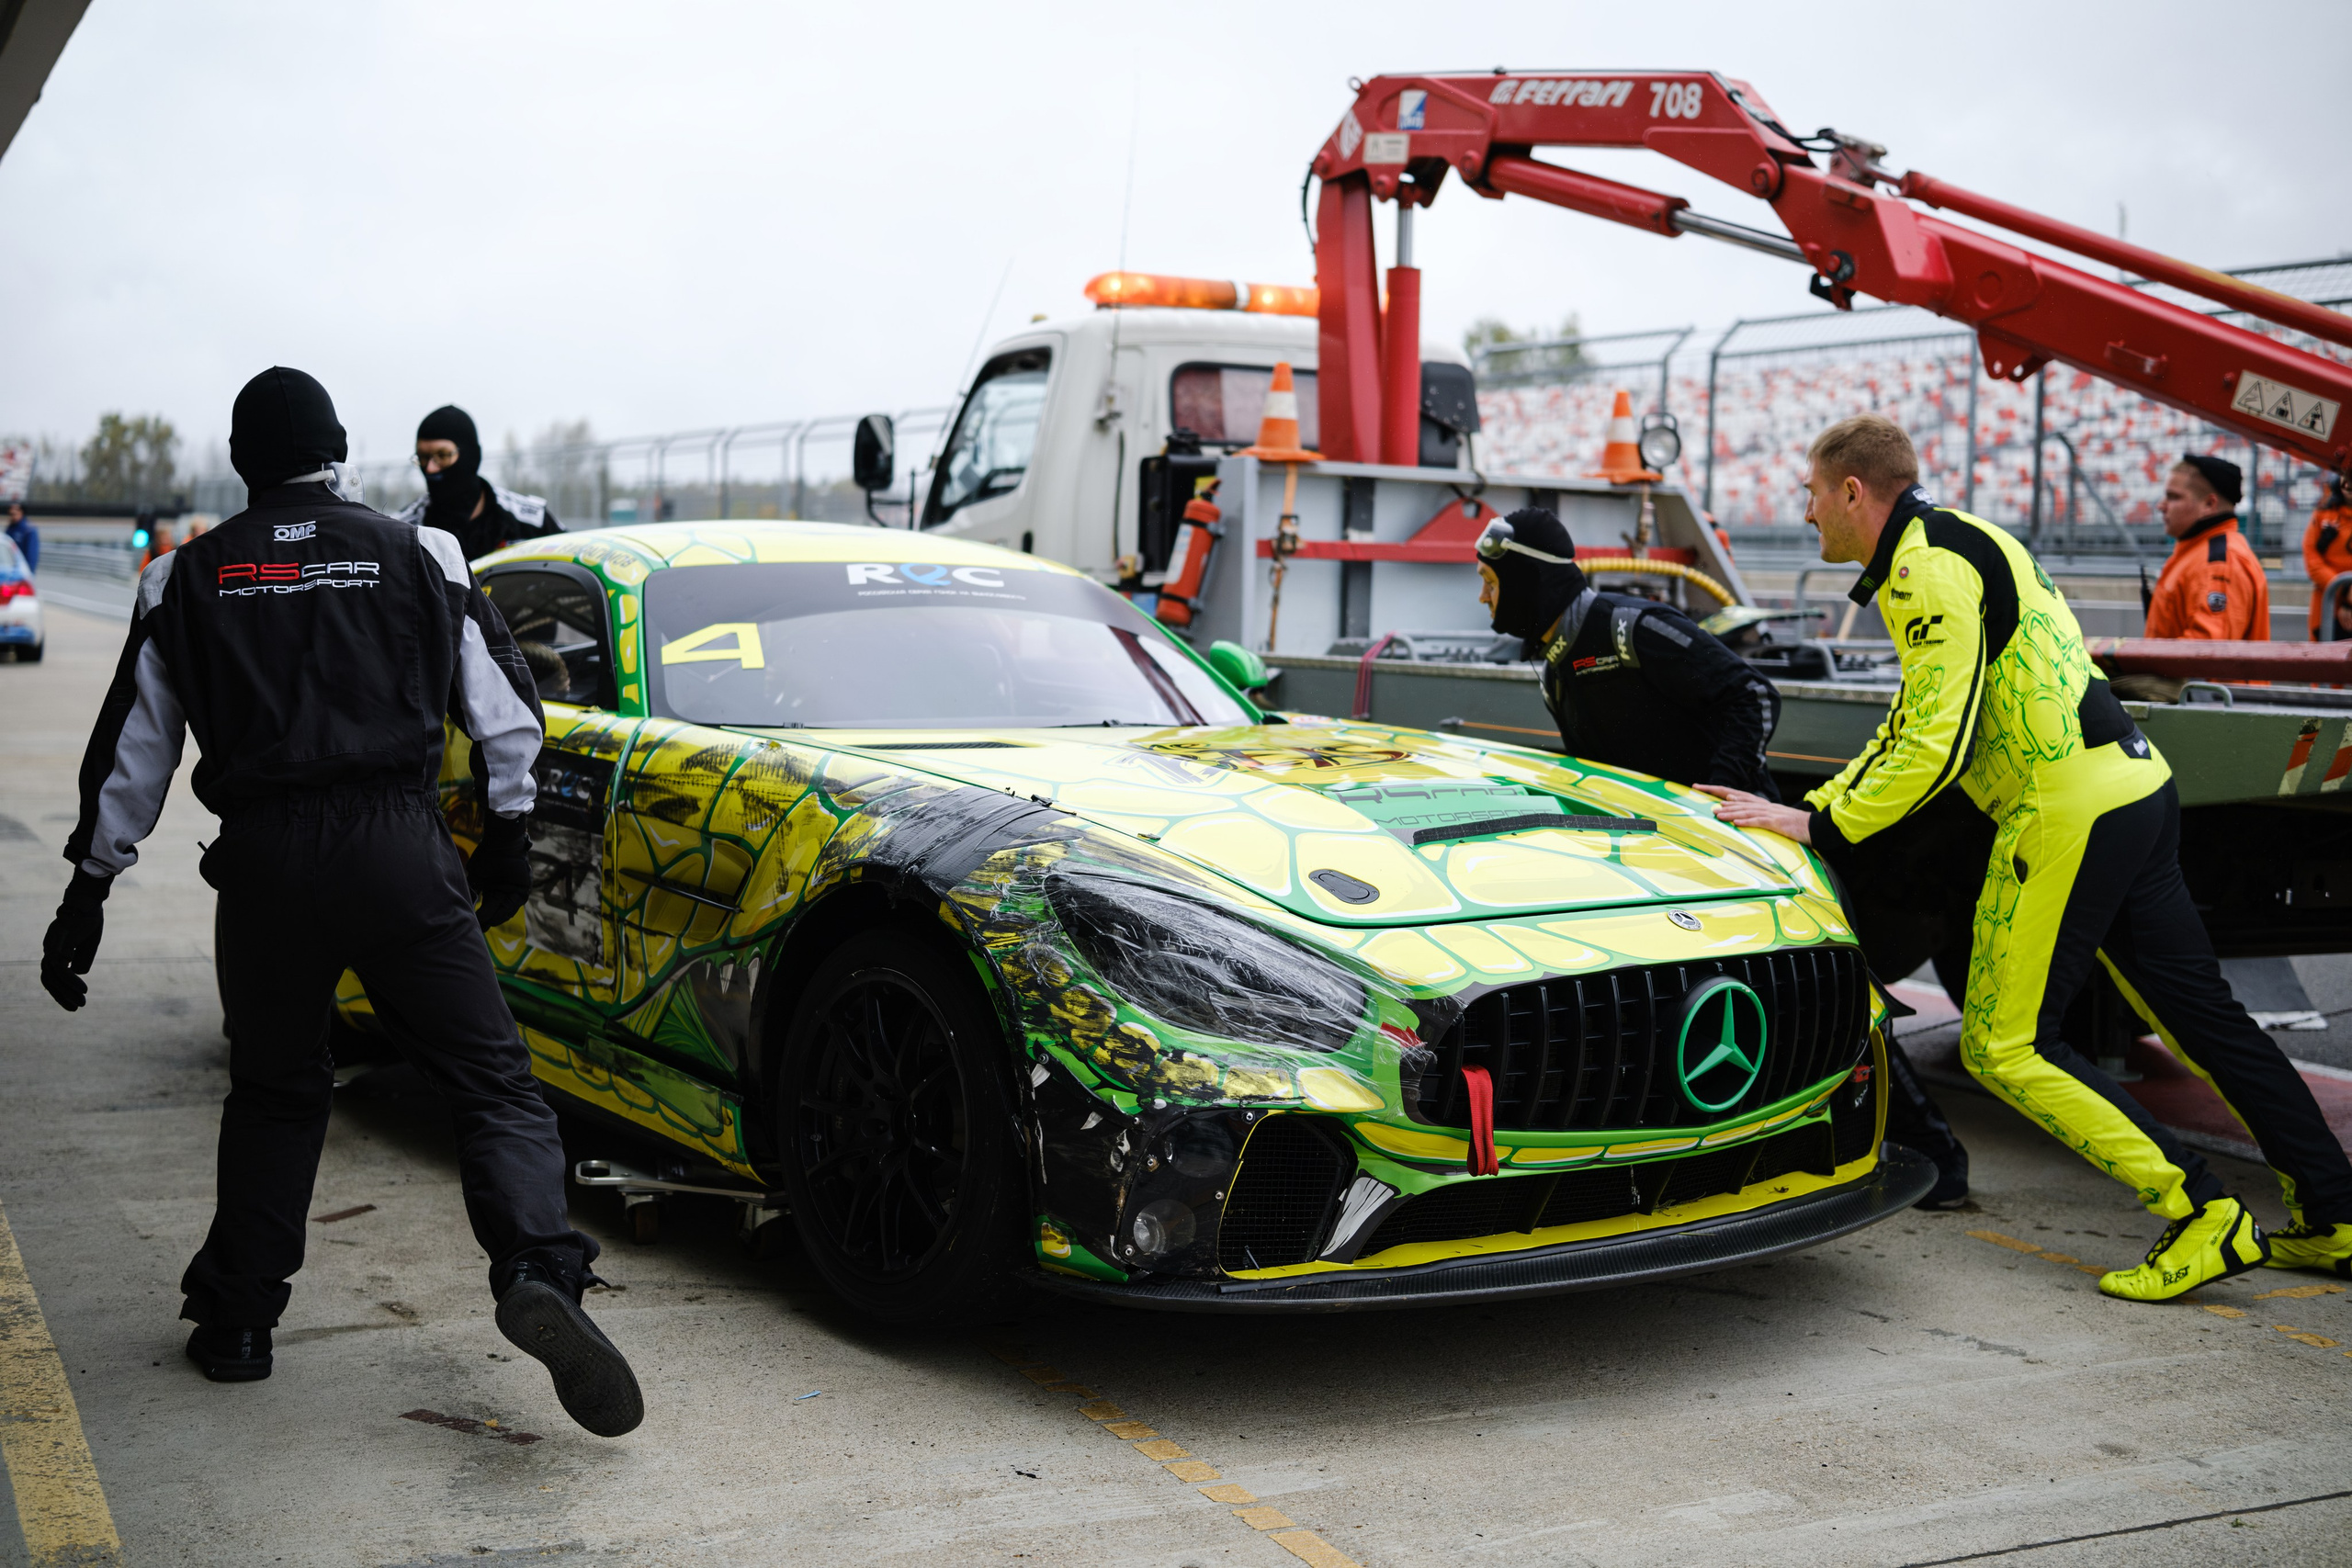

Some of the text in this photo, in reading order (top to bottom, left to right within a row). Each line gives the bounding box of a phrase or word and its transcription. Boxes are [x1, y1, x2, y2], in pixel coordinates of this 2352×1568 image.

[1648, 82, 1702, 119] 708
[274, 521, 316, 541] OMP
[218, 561, 379, 584] RSCAR
[219, 579, 379, 597] MOTORSPORT
[662, 622, 764, 670] 4
[1546, 635, 1567, 663] HRX
[1617, 618, 1631, 660] HRX
